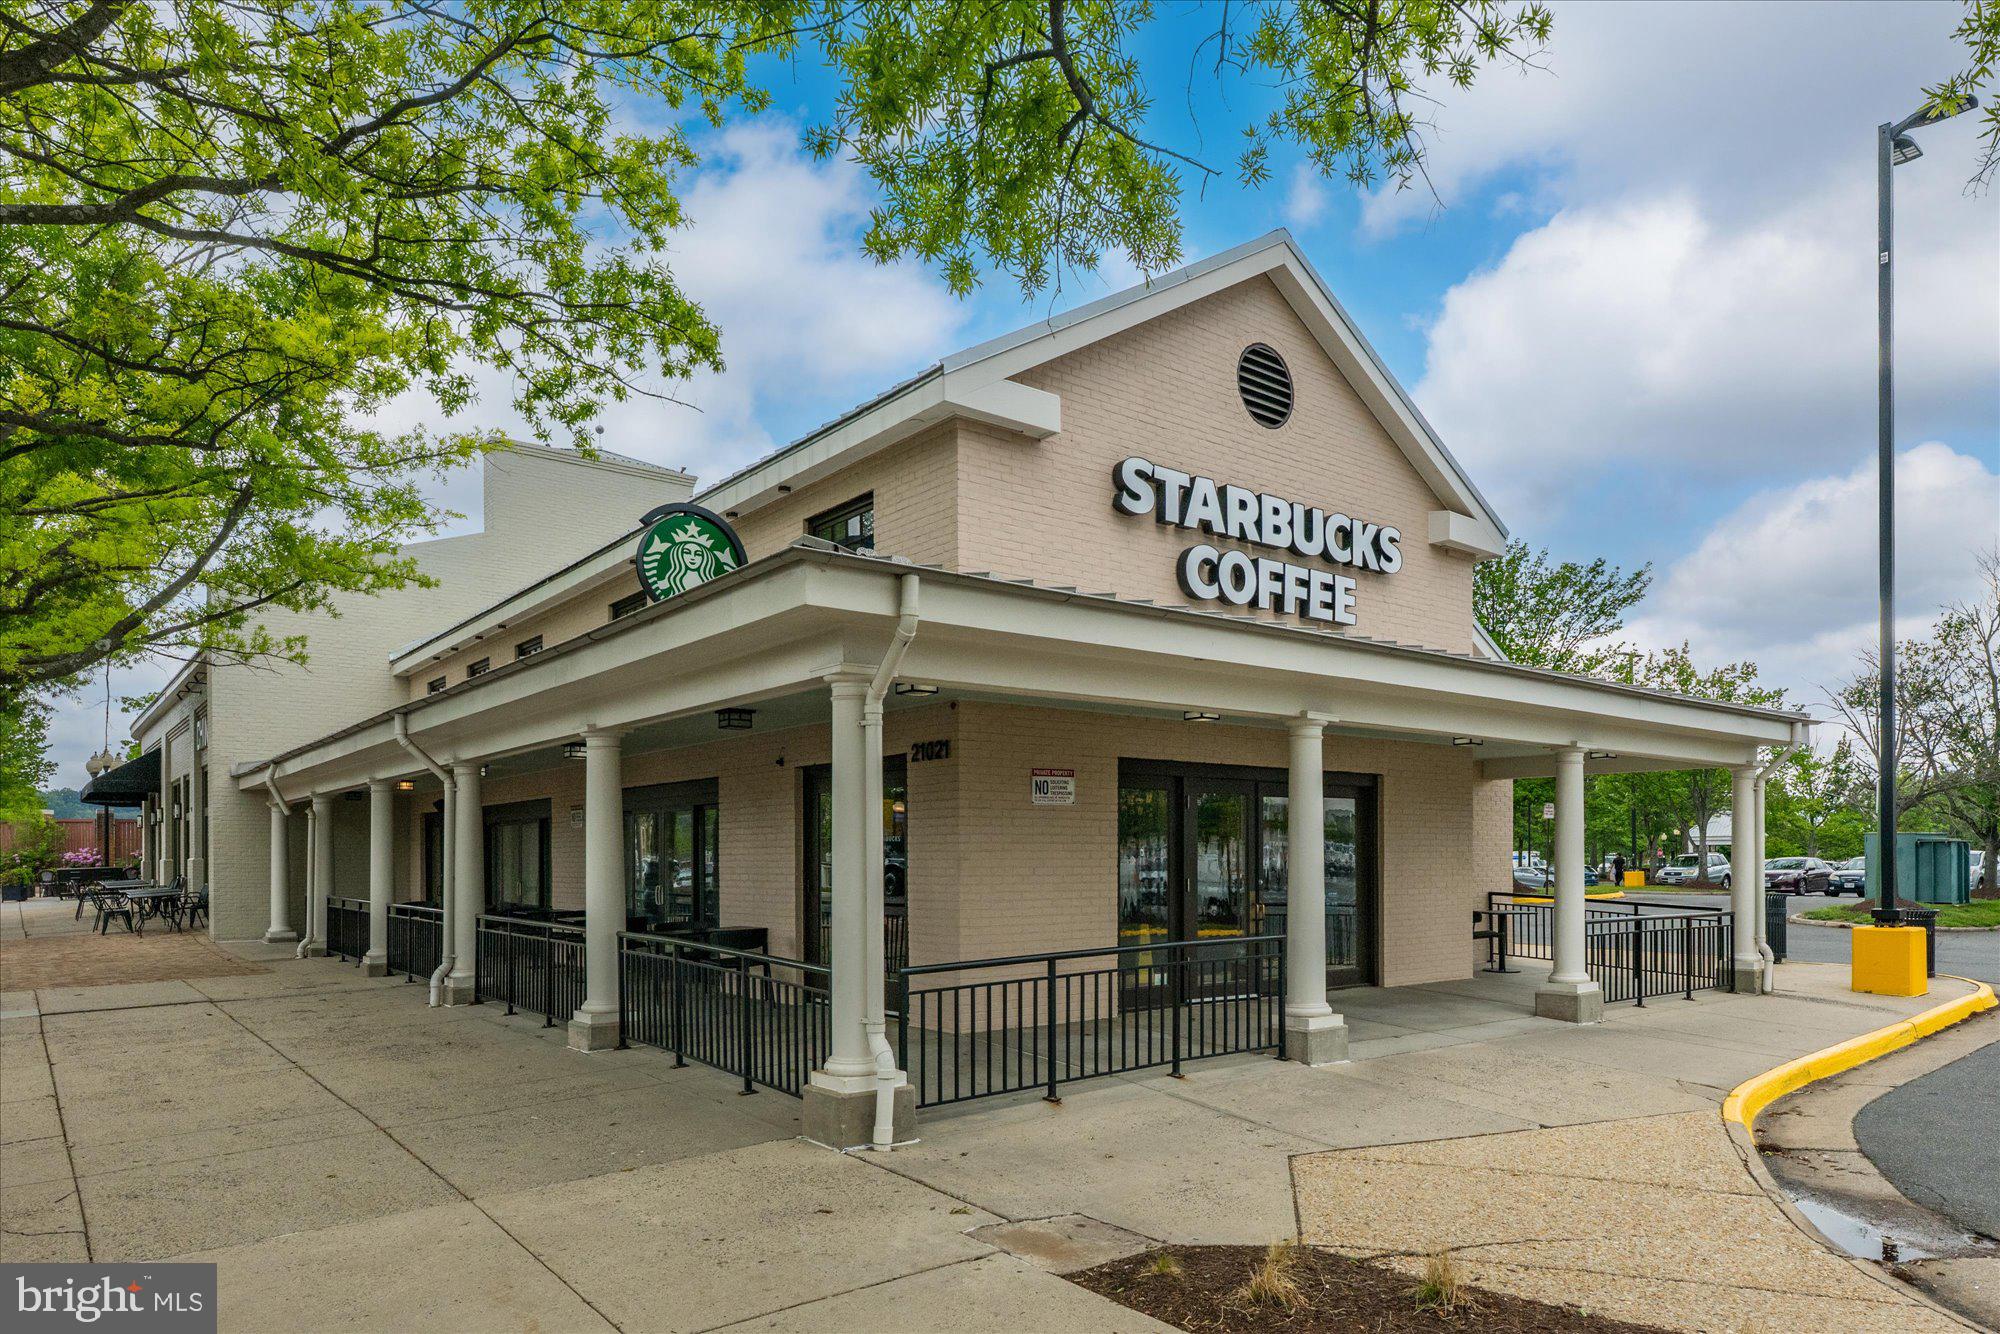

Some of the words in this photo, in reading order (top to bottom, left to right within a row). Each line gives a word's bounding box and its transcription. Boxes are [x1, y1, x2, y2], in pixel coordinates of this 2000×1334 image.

[1113, 457, 1402, 575] STARBUCKS
[1177, 544, 1357, 626] COFFEE
[1034, 779, 1049, 796] NO
